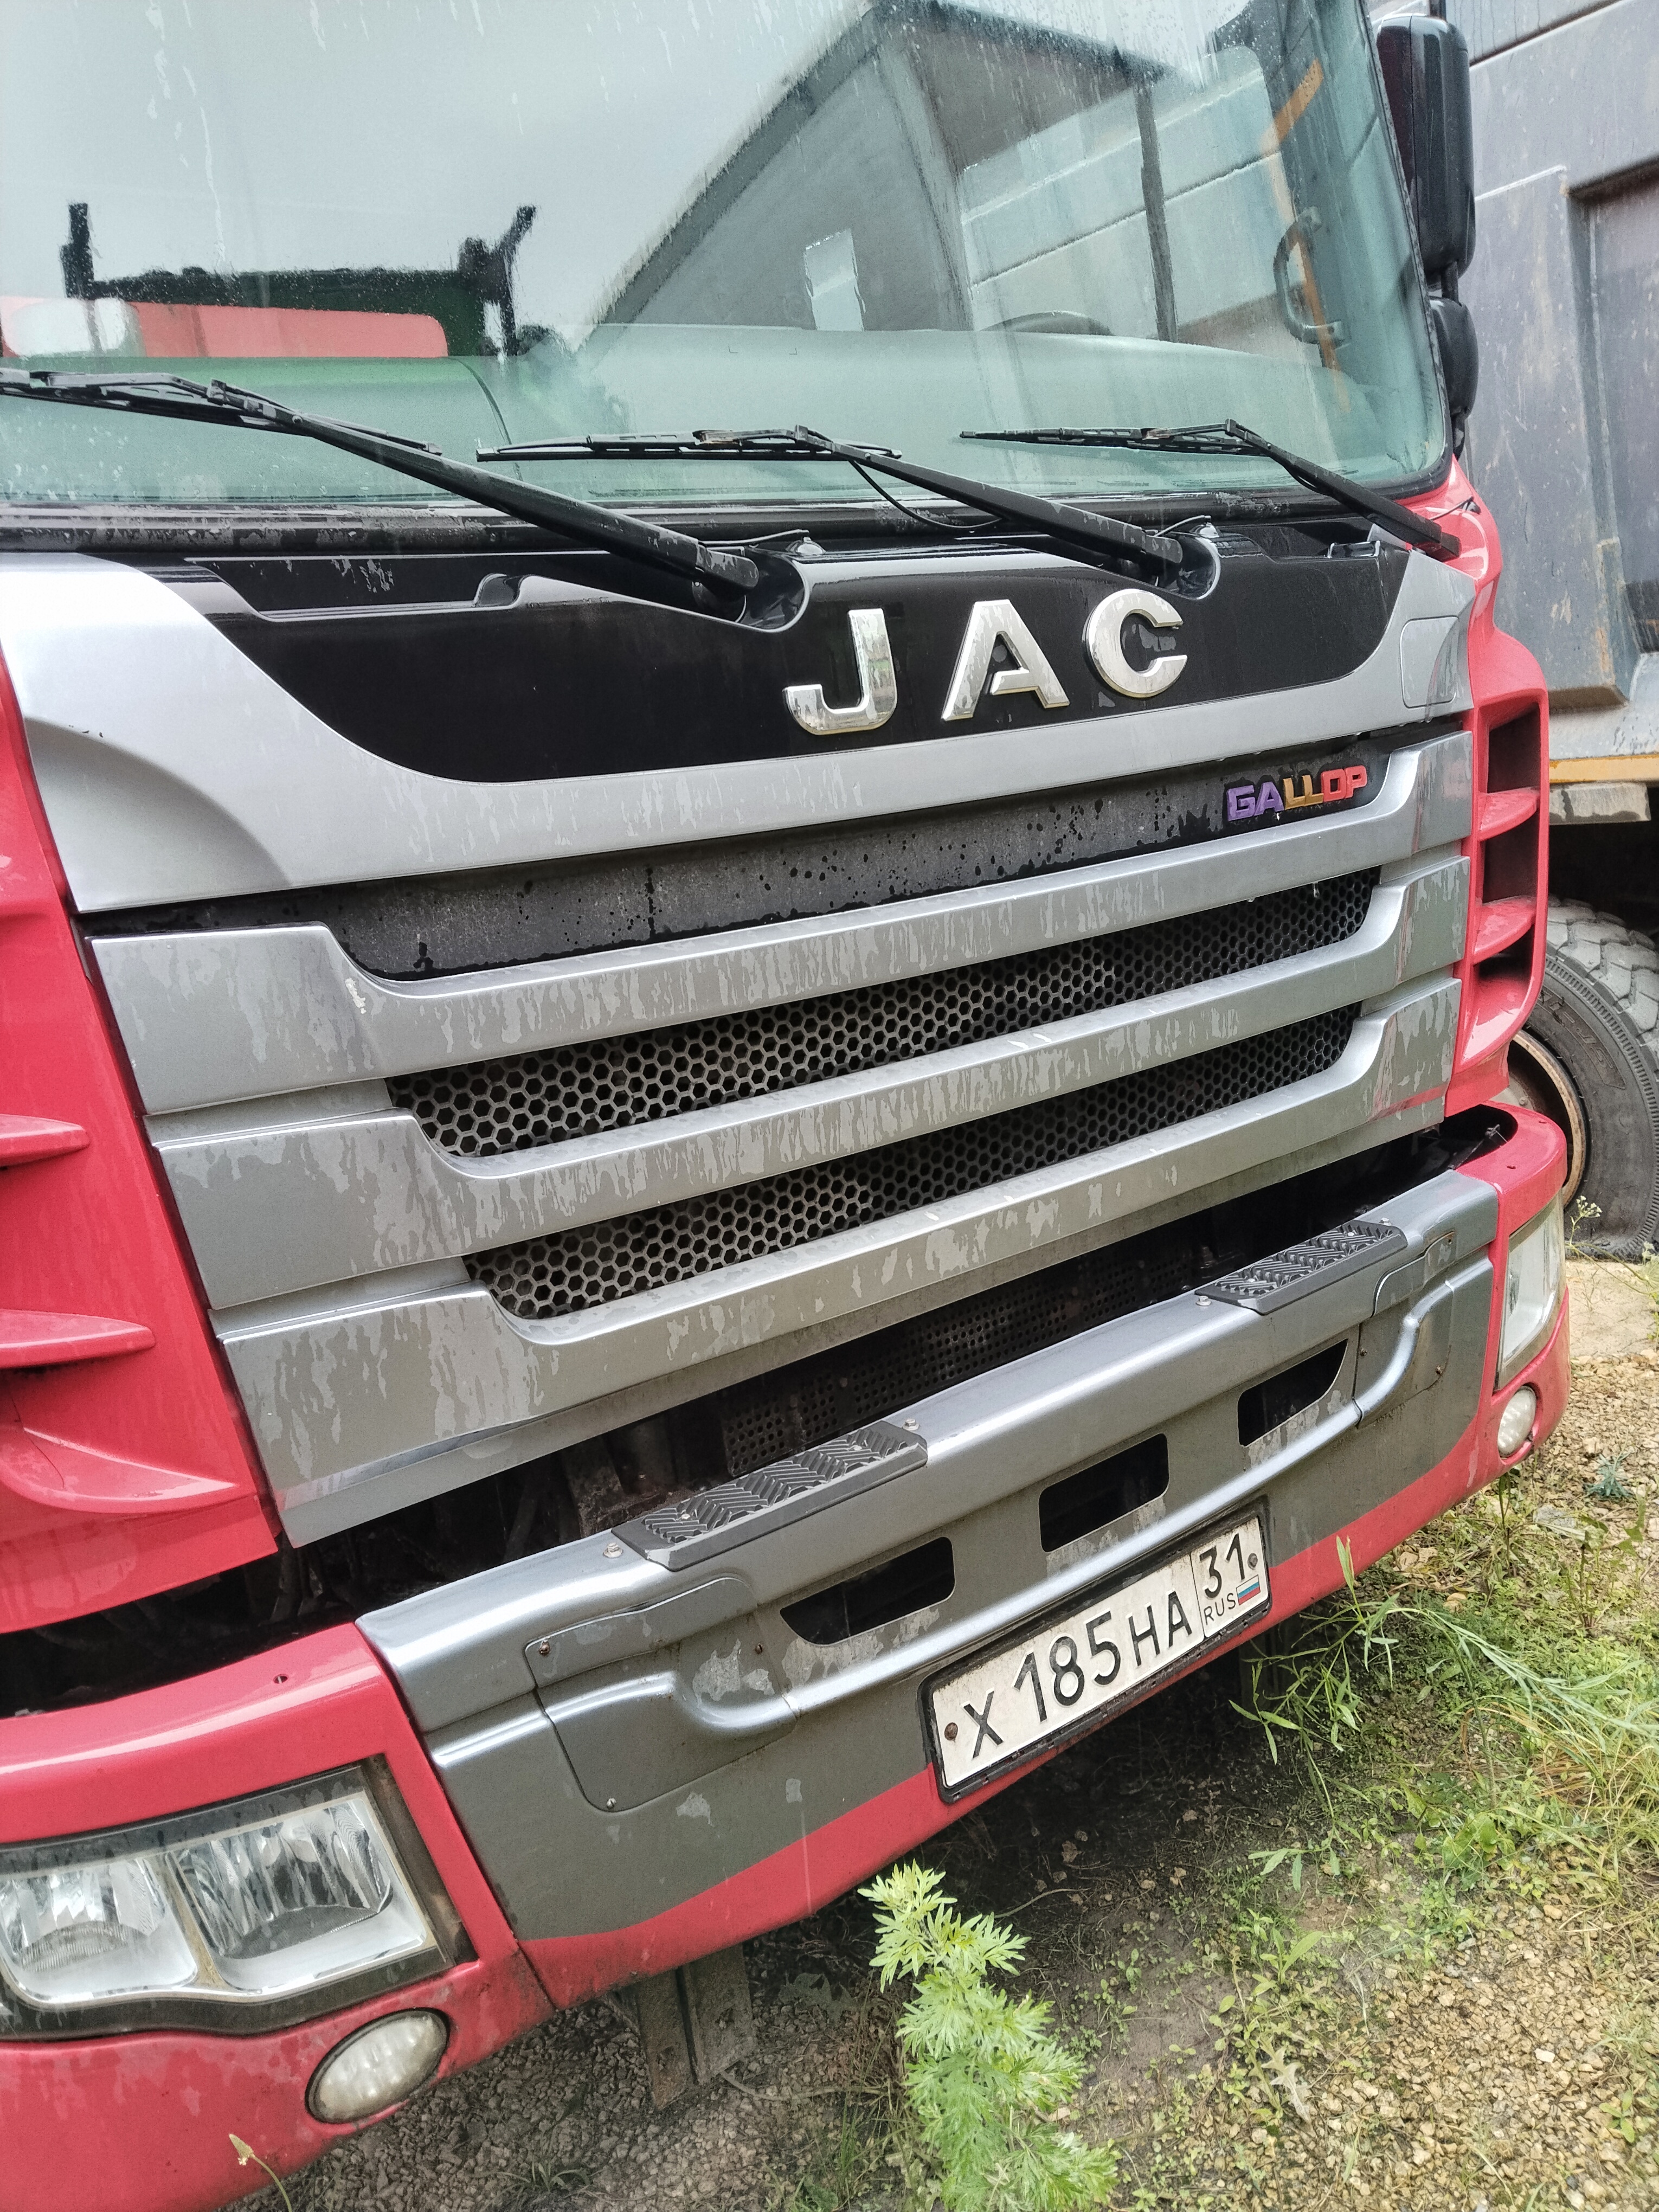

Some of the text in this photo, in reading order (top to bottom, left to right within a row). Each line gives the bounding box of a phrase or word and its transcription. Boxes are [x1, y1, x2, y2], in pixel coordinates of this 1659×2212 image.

[783, 588, 1188, 735] JAC
[1226, 765, 1367, 821] GALLOP
[1199, 1532, 1246, 1599] 31
[1203, 1592, 1237, 1625] RUS
